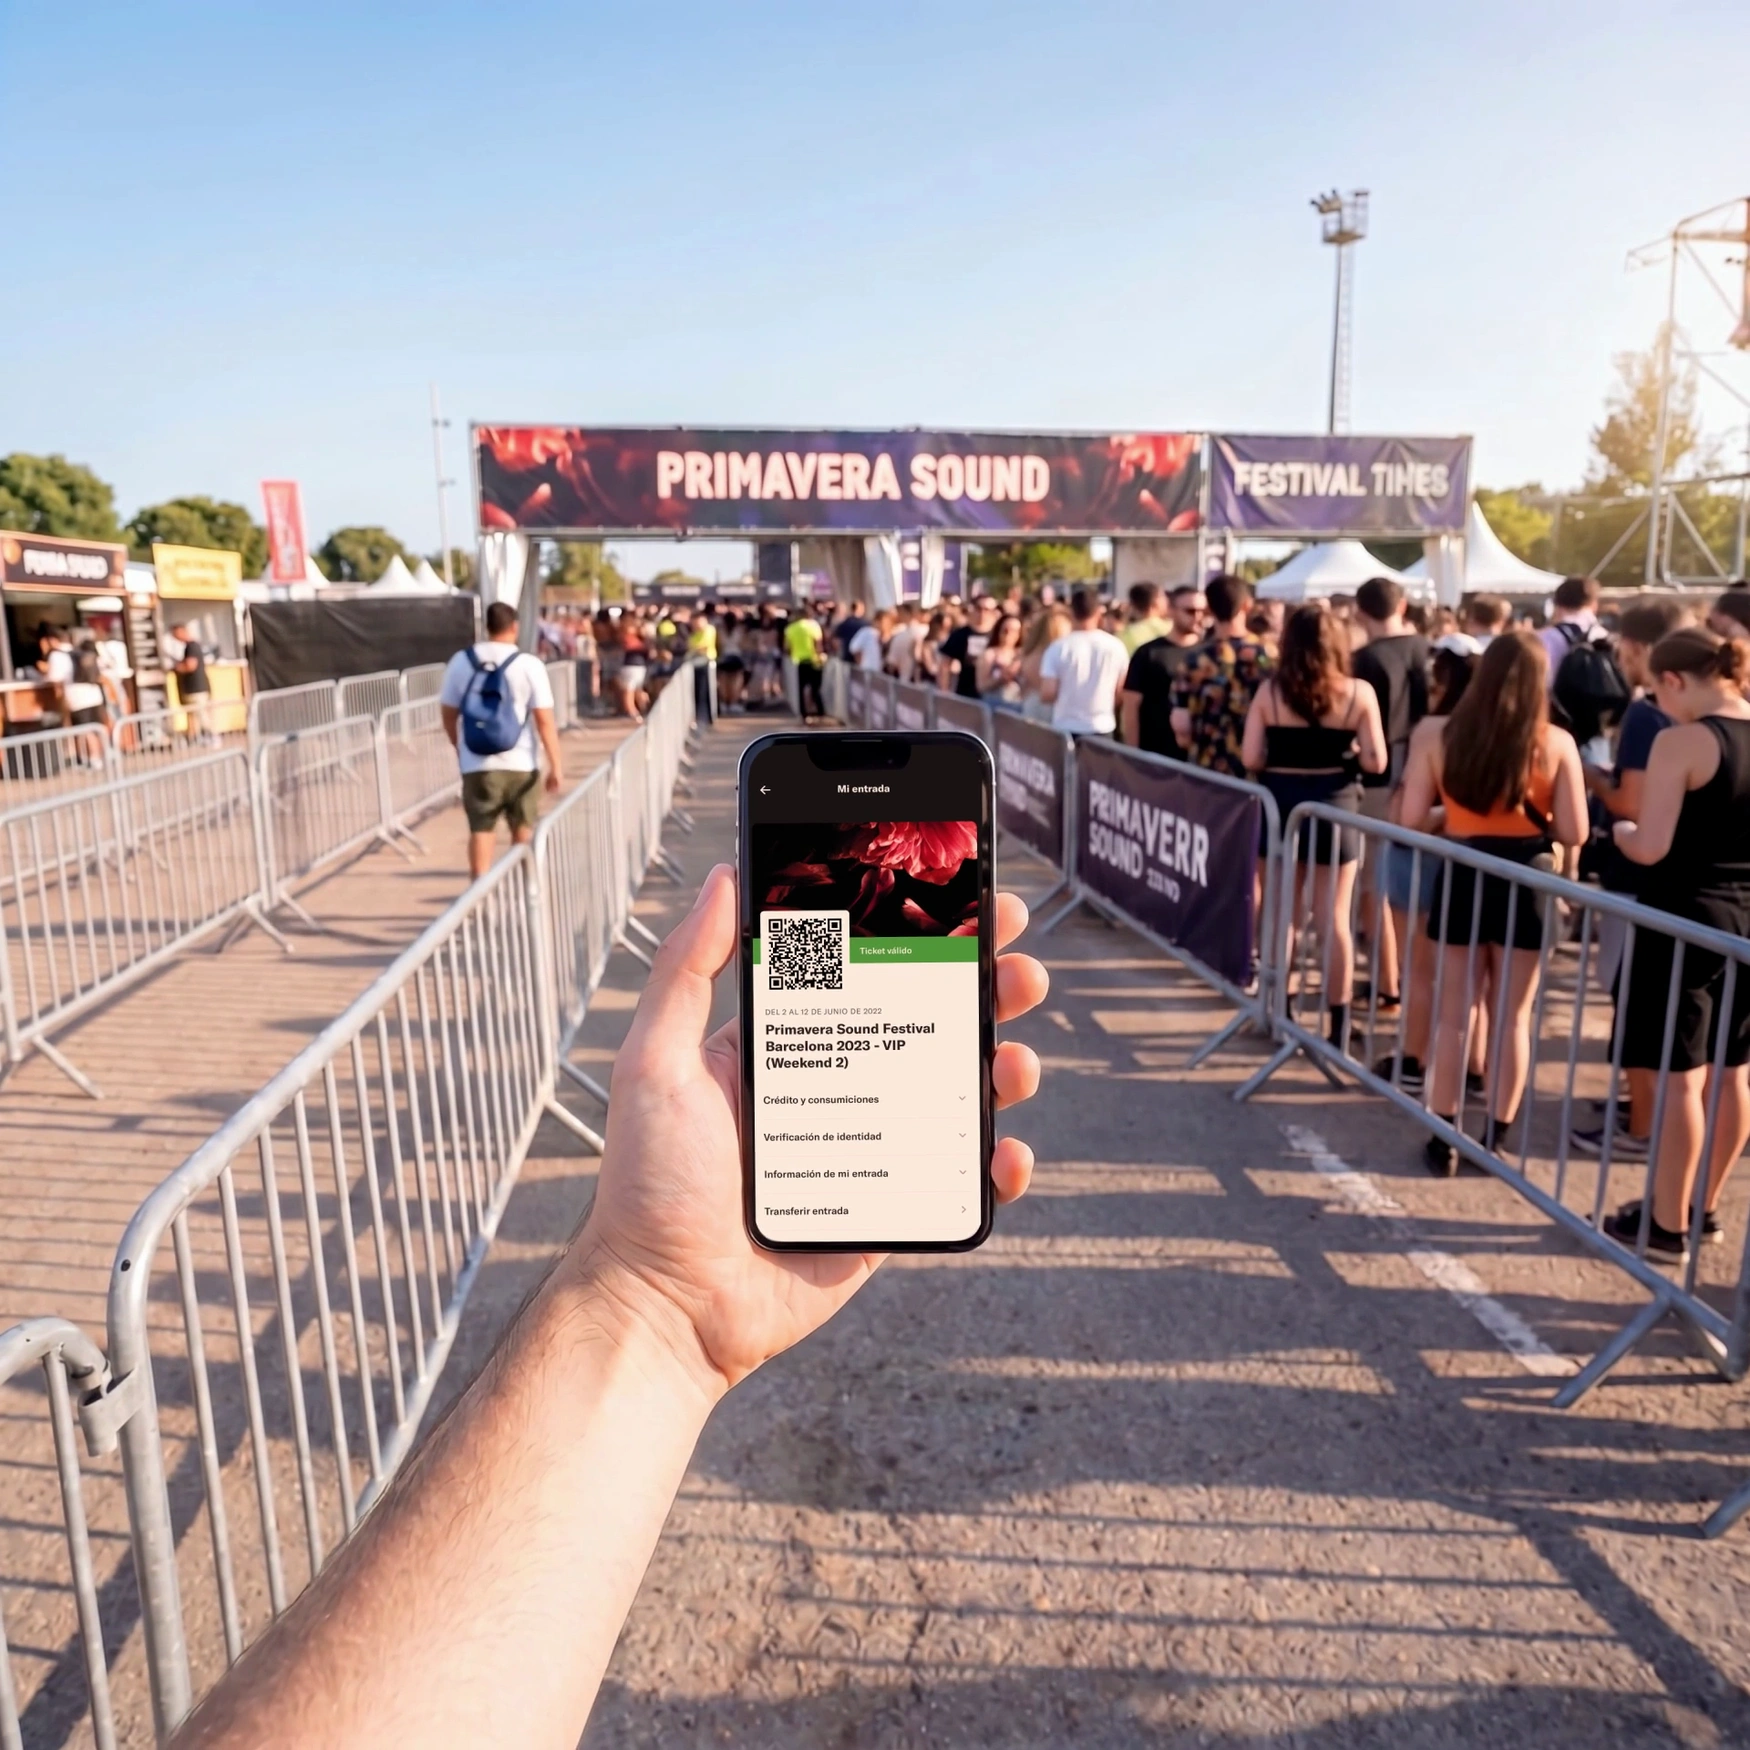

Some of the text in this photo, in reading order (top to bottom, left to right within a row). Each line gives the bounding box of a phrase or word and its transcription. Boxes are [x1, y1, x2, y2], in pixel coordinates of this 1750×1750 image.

[656, 450, 1050, 502] PRIMAVERA SOUND
[1234, 462, 1367, 497] FESTIVAL
[837, 784, 891, 794] Mi entrada
[1088, 821, 1144, 879] SOUND
[860, 946, 913, 955] Ticket válido
[765, 1008, 781, 1016] DEL
[781, 1008, 788, 1016] 2
[789, 1008, 799, 1016] AL
[801, 1008, 809, 1016] 12
[811, 1008, 822, 1016] DE
[823, 1008, 849, 1016] JUNIO
[863, 1007, 883, 1015] 2022
[765, 1022, 935, 1036] Primavera Sound Festival
[765, 1040, 834, 1052] Barcelona
[836, 1040, 871, 1052] 2023
[882, 1039, 906, 1051] VIP
[765, 1056, 849, 1070] (Weekend 2)
[763, 1095, 880, 1106] Crédito y consumiciones
[763, 1132, 882, 1142] Verificación de identidad
[764, 1169, 889, 1179] Información de mi entrada
[764, 1206, 849, 1216] Transferir entrada
